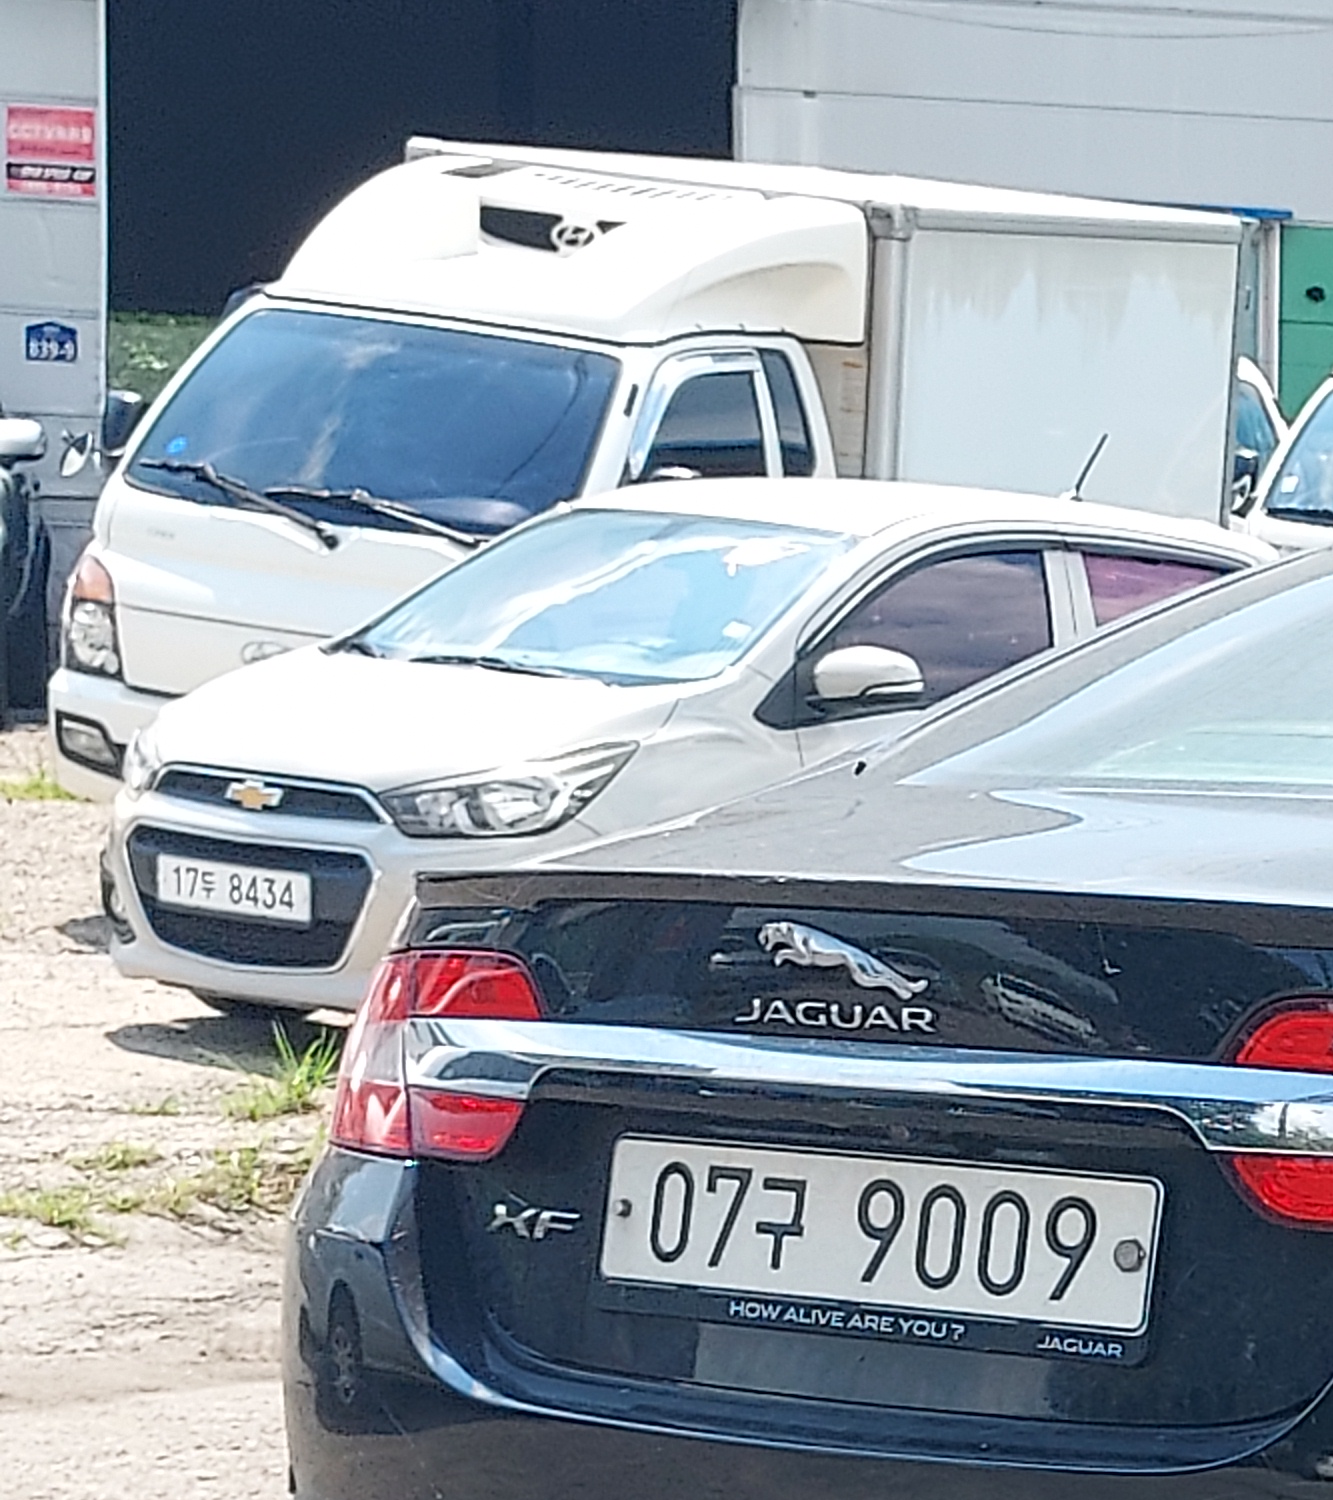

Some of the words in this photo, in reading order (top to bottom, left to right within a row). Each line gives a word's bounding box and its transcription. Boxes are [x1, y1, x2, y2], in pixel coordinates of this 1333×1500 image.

[172, 865, 215, 899] 17두
[229, 873, 295, 911] 8434
[734, 998, 937, 1033] JAGUAR
[485, 1203, 581, 1239] XF
[649, 1160, 807, 1270] 07구
[856, 1178, 1098, 1302] 9009
[728, 1300, 783, 1322] HOW
[784, 1307, 845, 1329] ALIVE
[846, 1313, 894, 1334] ARE
[1036, 1334, 1124, 1360] JAGUAR
